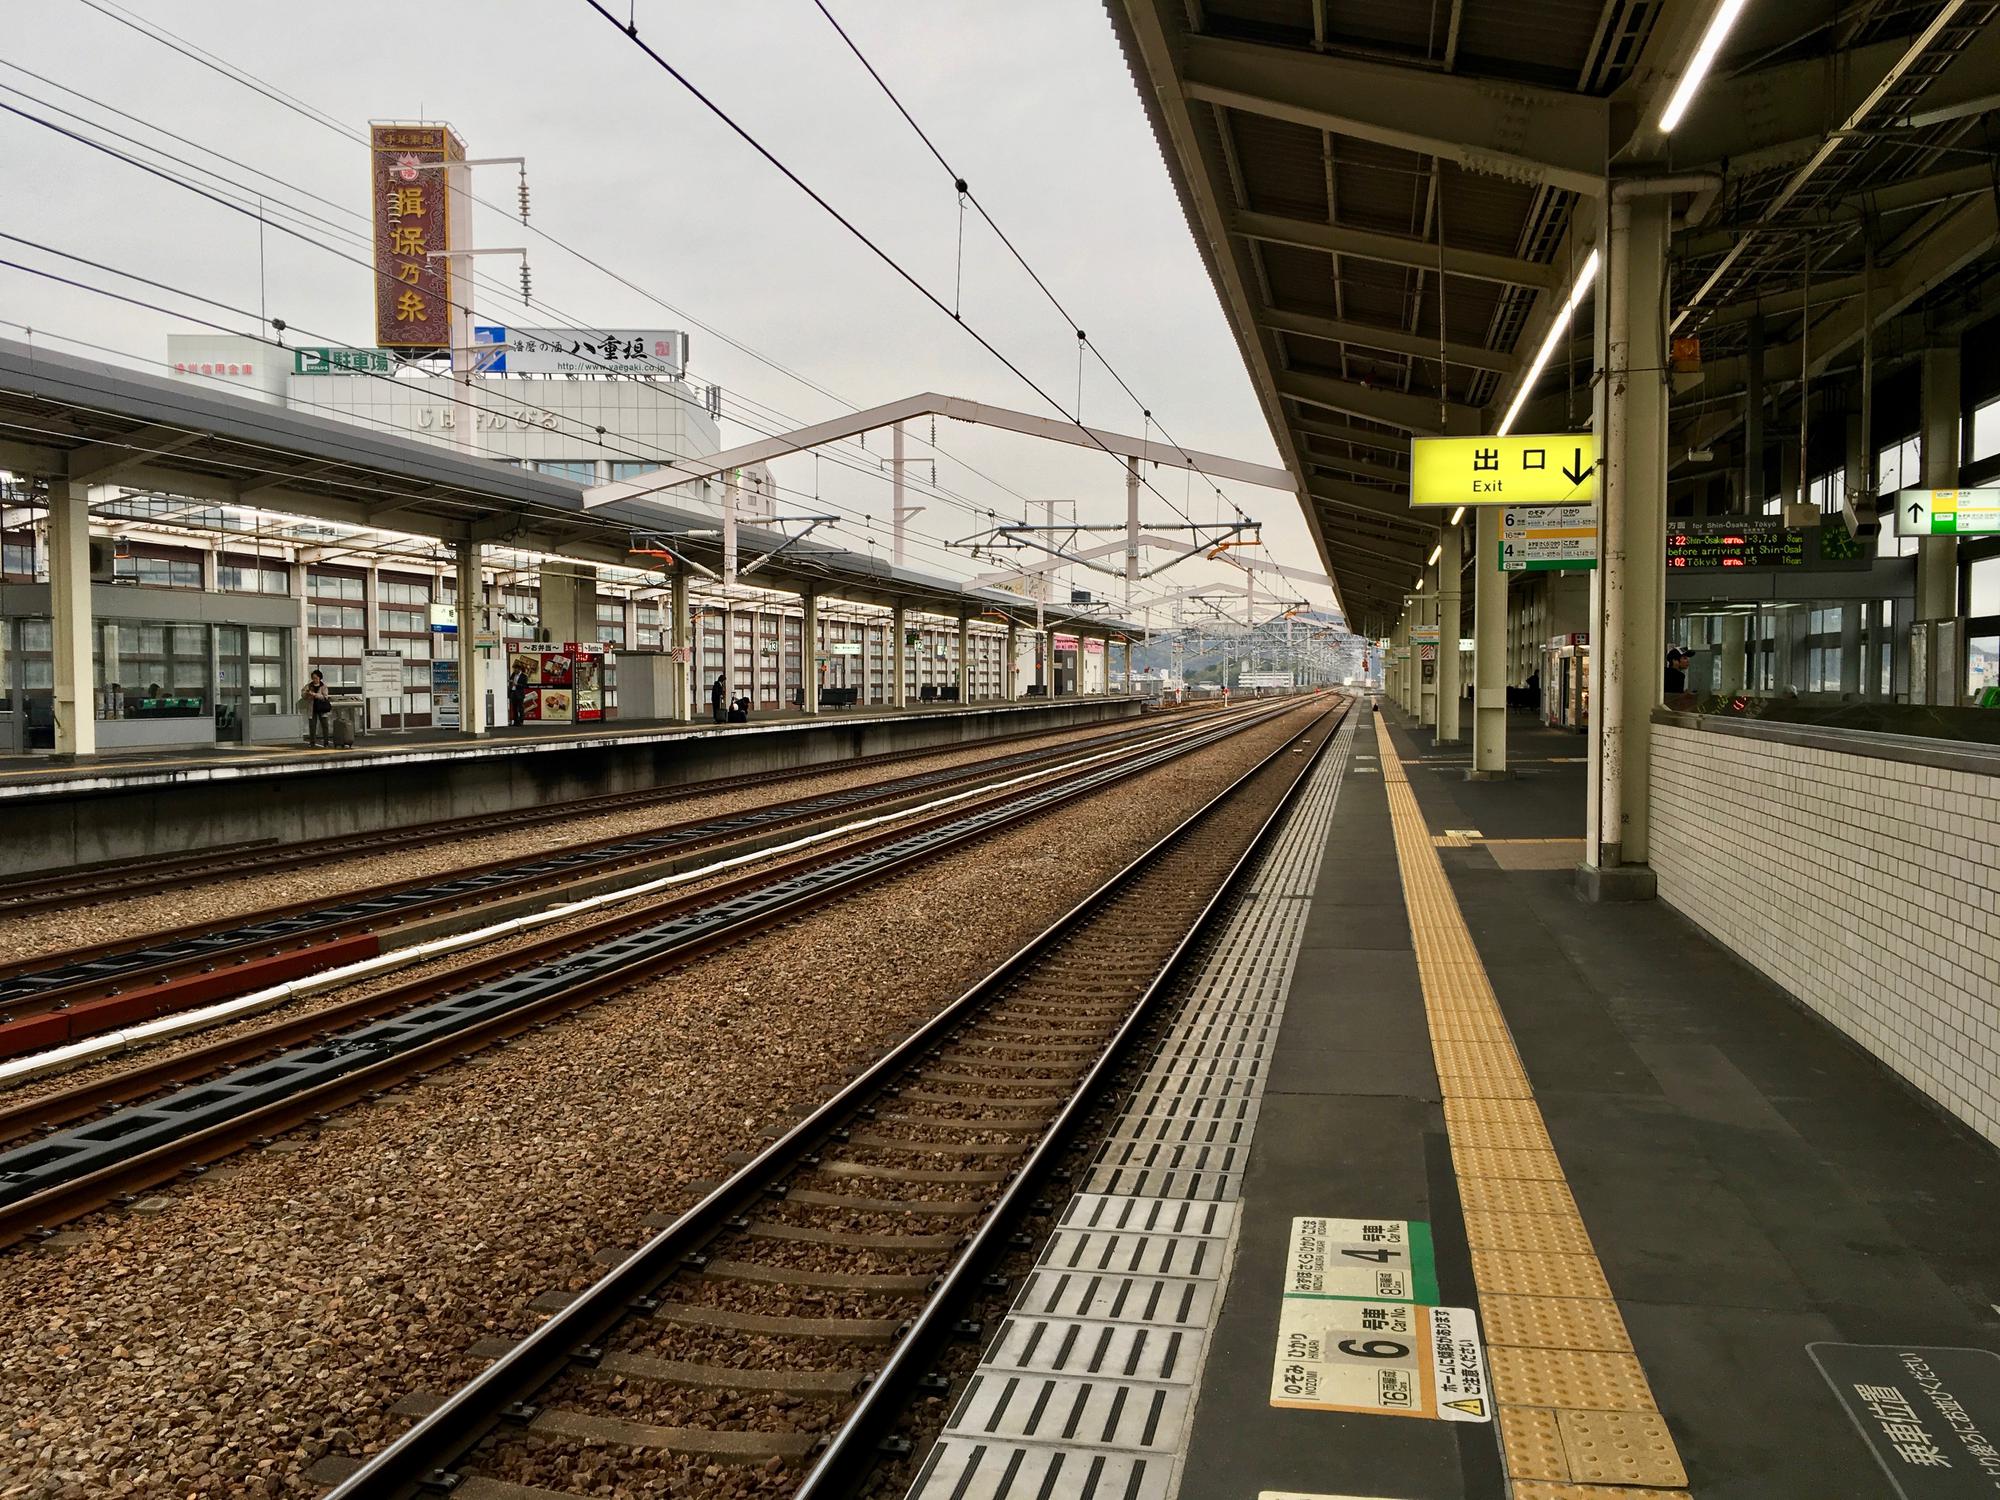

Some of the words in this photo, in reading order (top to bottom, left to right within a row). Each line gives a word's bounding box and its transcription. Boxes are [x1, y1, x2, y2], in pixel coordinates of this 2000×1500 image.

[570, 335, 648, 361] 八重垣
[301, 350, 321, 371] P
[333, 351, 388, 371] 駐車場
[1473, 448, 1546, 471] 出口
[1473, 480, 1503, 492] Exit
[1505, 514, 1514, 527] 6
[1504, 544, 1514, 556] 4
[1667, 547, 1698, 556] before
[1702, 546, 1742, 556] arriving
[1744, 547, 1754, 555] at
[769, 642, 777, 651] 13
[915, 642, 922, 650] 12
[1301, 1220, 1317, 1236] こだま
[1362, 1224, 1386, 1243] 号車
[1386, 1223, 1401, 1233] No.
[1300, 1236, 1316, 1252] ひかり
[1387, 1233, 1401, 1243] Car
[1299, 1253, 1315, 1270] さくら
[1341, 1248, 1402, 1263] 4
[1295, 1271, 1313, 1291] みずほ
[1361, 1307, 1390, 1331] 号車
[1390, 1306, 1406, 1319] No.
[1390, 1319, 1407, 1333] Car
[1287, 1333, 1308, 1358] ひかり
[1307, 1339, 1320, 1360] HIKARI
[1337, 1339, 1410, 1359] 6
[1433, 1309, 1458, 1393] ホームに傾斜があります
[1458, 1339, 1481, 1395] ご注意ください
[1283, 1364, 1305, 1395] のぞみ
[1304, 1370, 1318, 1396] NOZOMI
[1399, 1381, 1409, 1392] Cars
[1382, 1391, 1409, 1406] 16
[1853, 1384, 1953, 1468] 乗車位置
